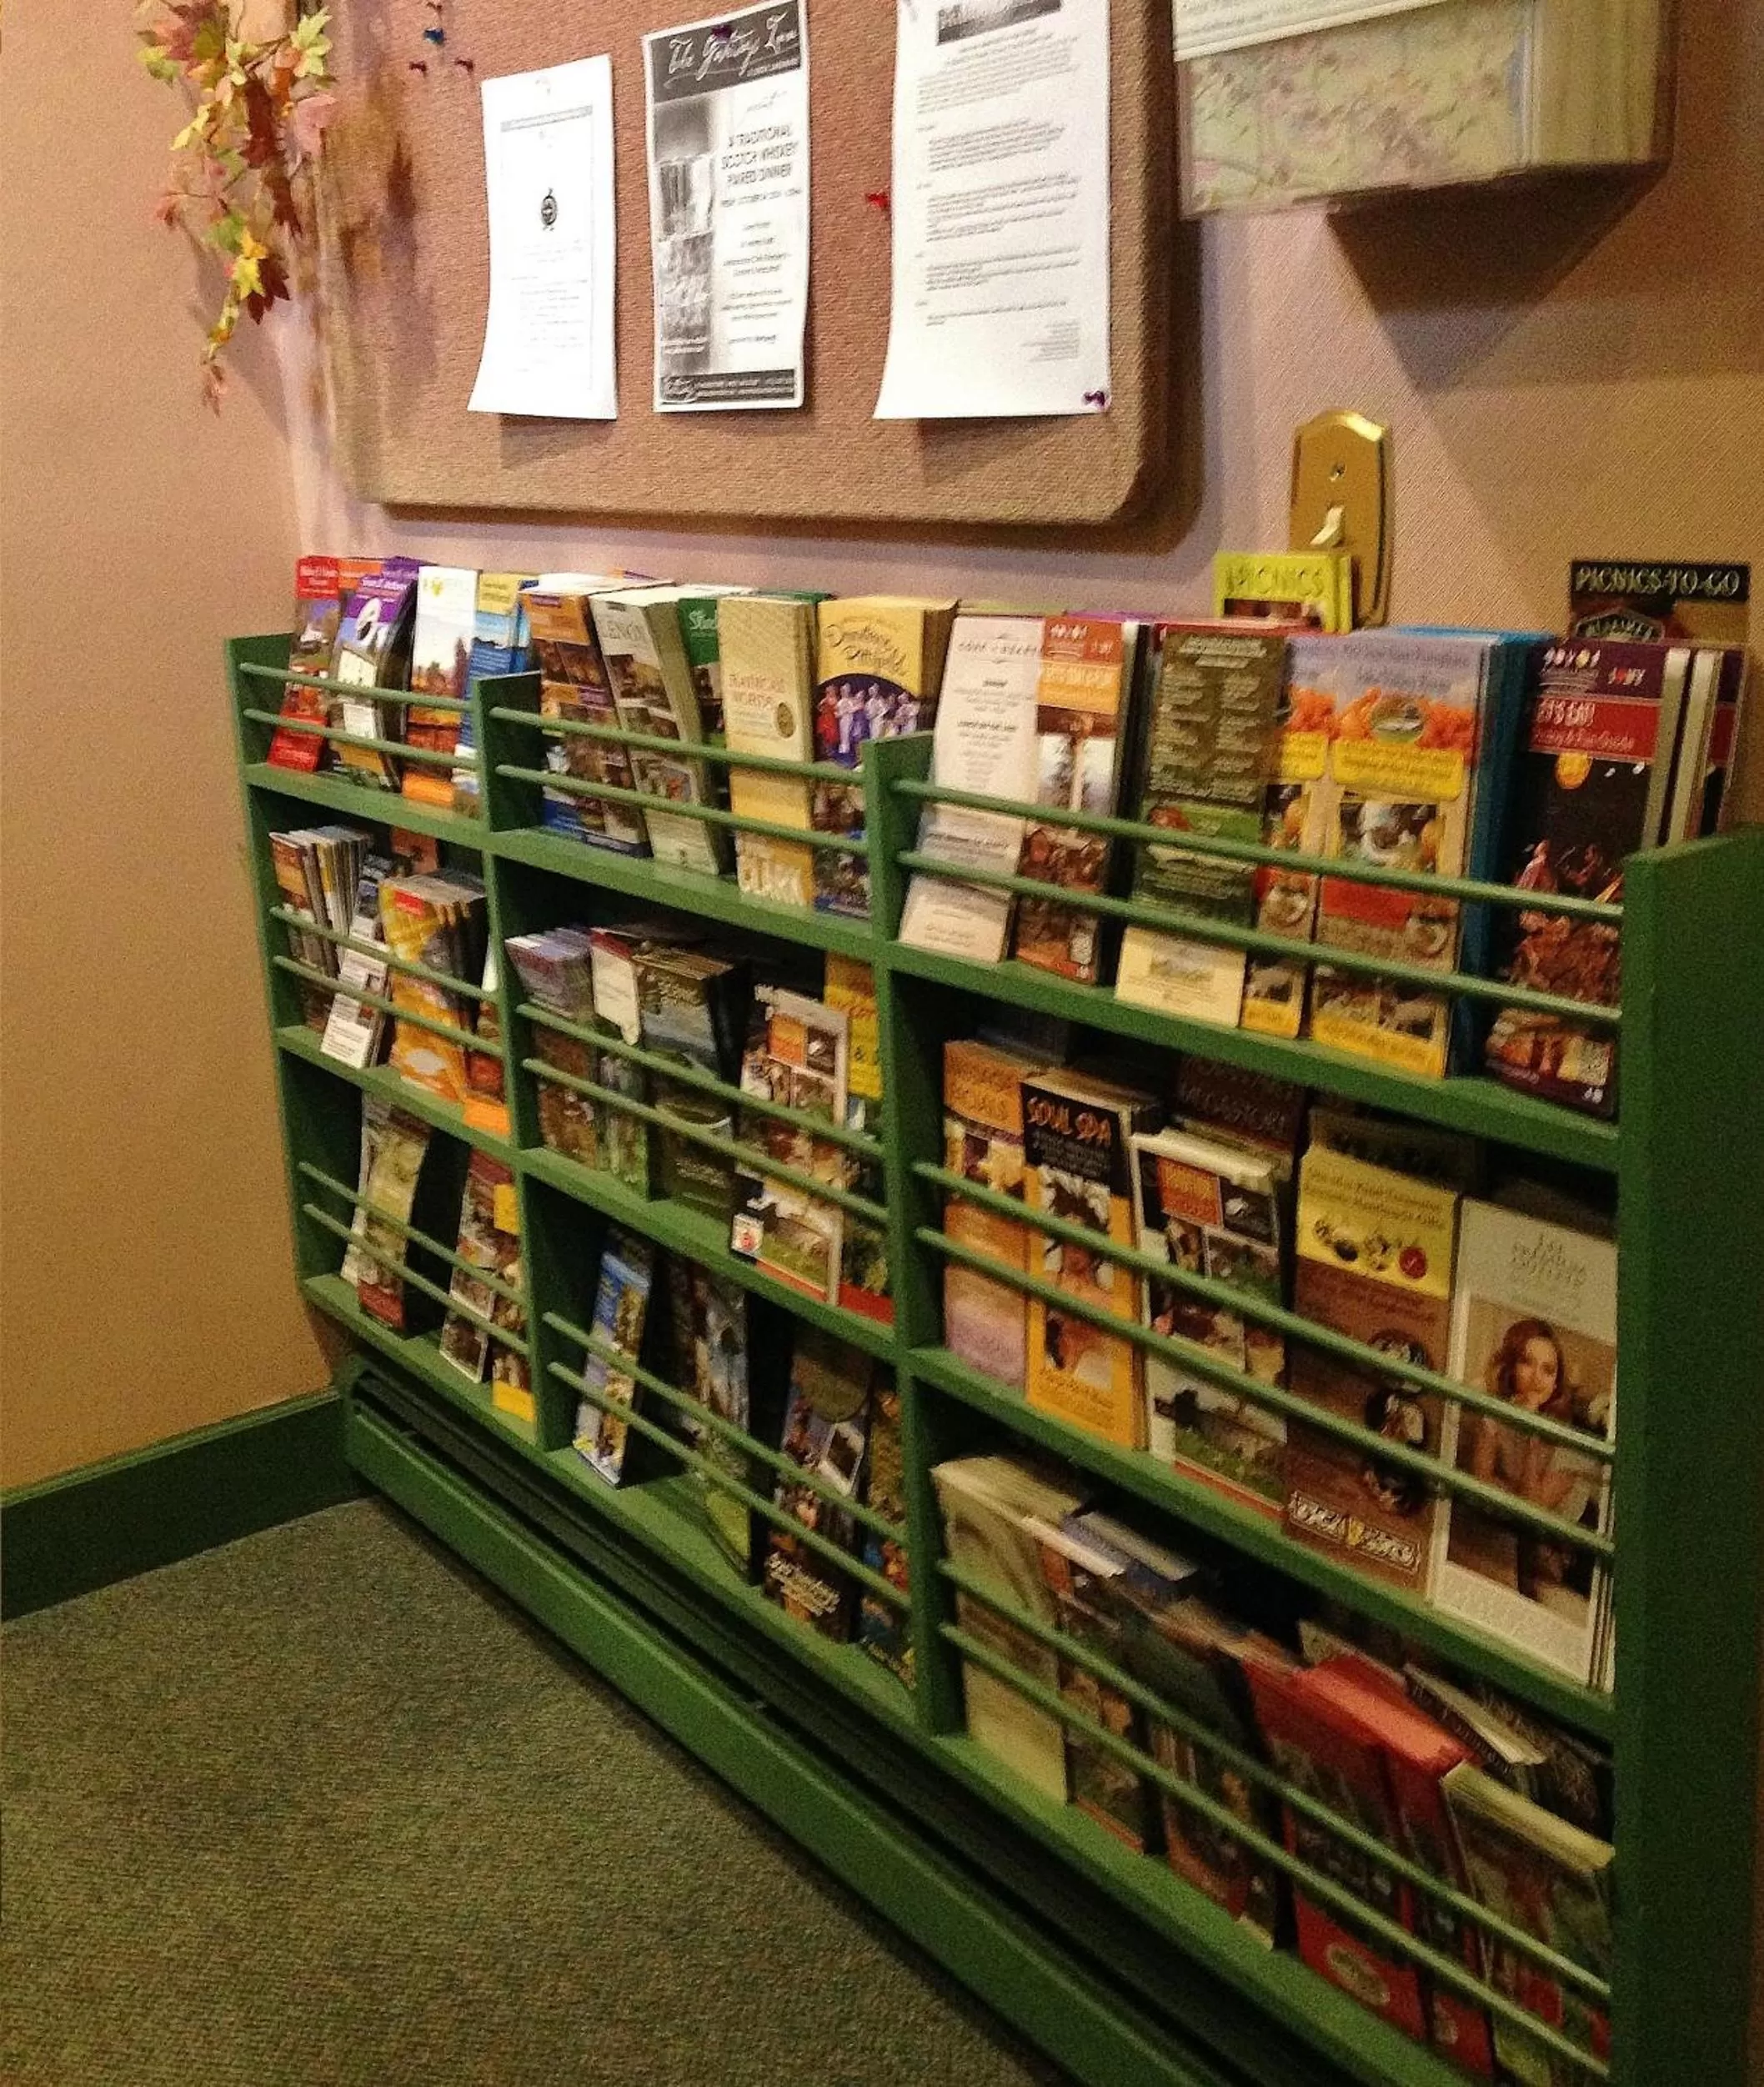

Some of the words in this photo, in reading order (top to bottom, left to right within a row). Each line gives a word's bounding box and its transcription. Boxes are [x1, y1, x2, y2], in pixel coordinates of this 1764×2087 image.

[736, 125, 792, 145] TRADITIONAL
[721, 151, 757, 169] SCOTCH
[761, 142, 799, 161] WHISKEY
[758, 163, 791, 182] DINNER
[1226, 564, 1326, 597] PICNICS
[1026, 1096, 1073, 1135] SOUL
[1075, 1112, 1111, 1149] SPA
